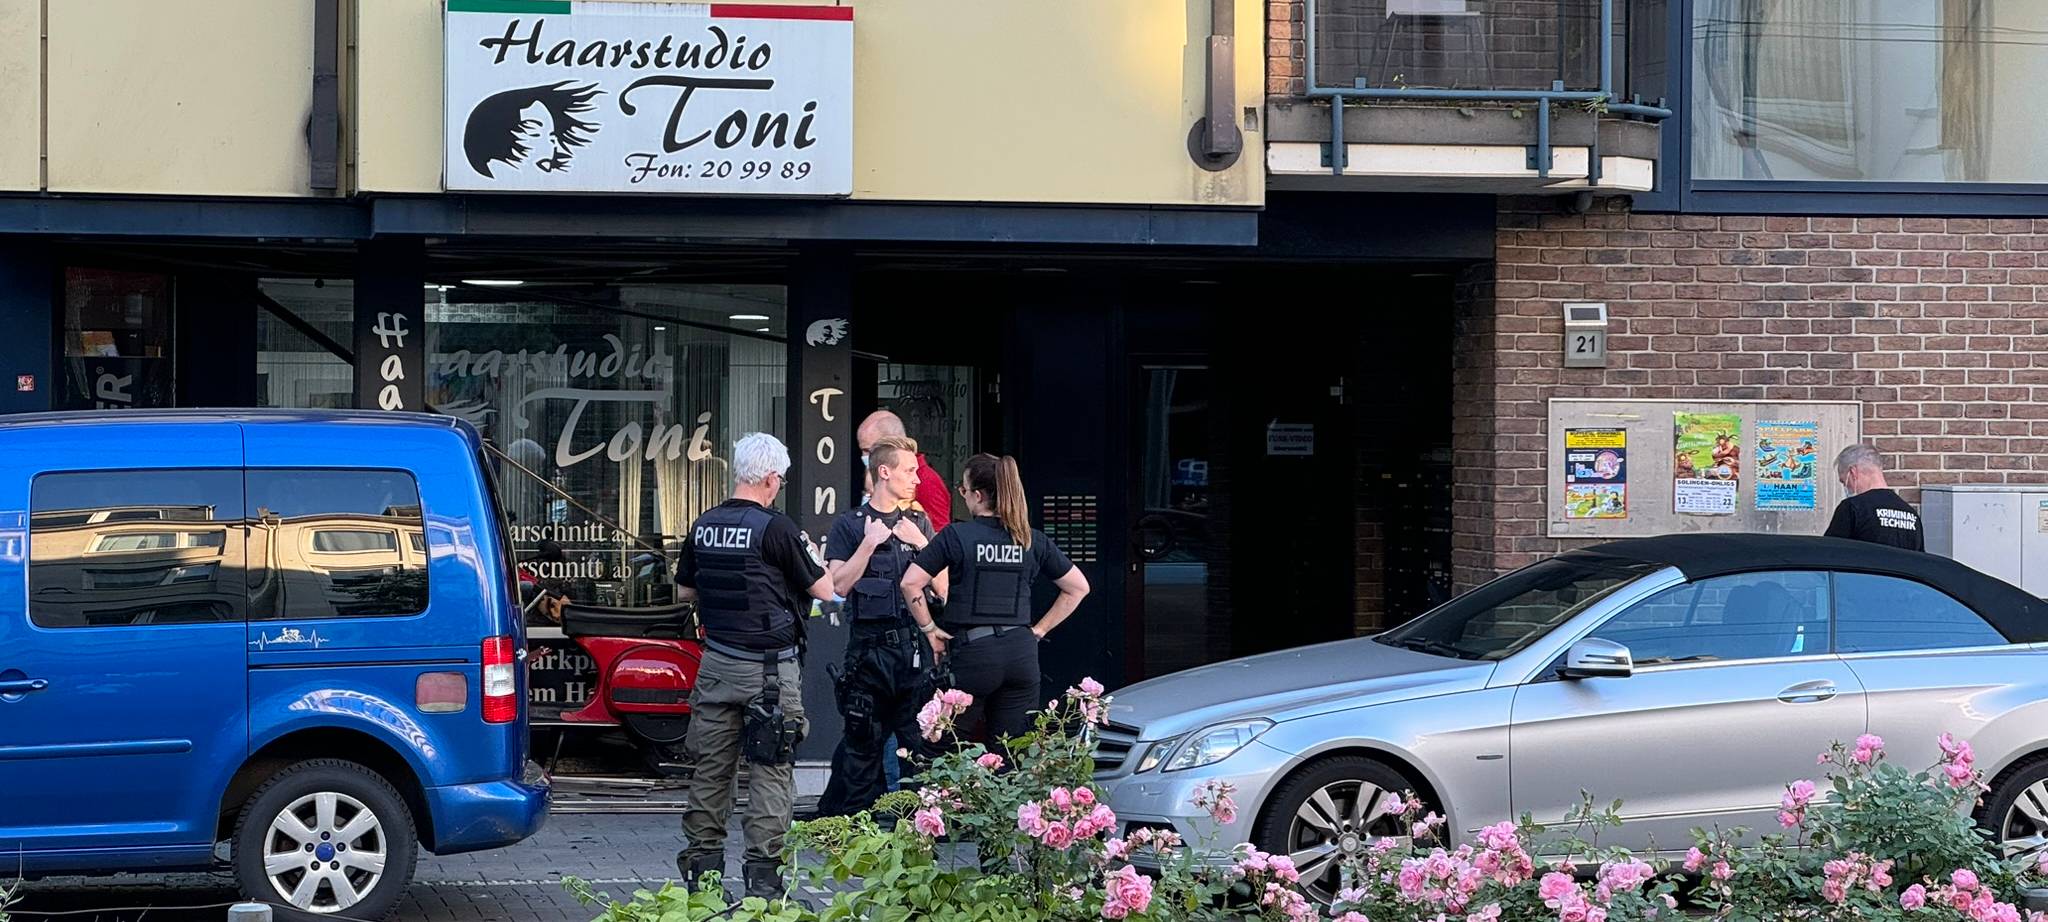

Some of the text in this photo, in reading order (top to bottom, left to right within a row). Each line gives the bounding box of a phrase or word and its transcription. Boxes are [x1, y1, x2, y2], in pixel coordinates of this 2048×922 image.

[479, 18, 772, 70] Haarstudio
[618, 75, 818, 154] Toni
[625, 153, 812, 184] Fon: 20 99 89
[1576, 335, 1595, 353] 21
[511, 386, 713, 468] Toni
[695, 525, 753, 549] POLIZEI
[1879, 517, 1917, 531] TECHNIK
[976, 543, 1024, 564] POLIZEI
